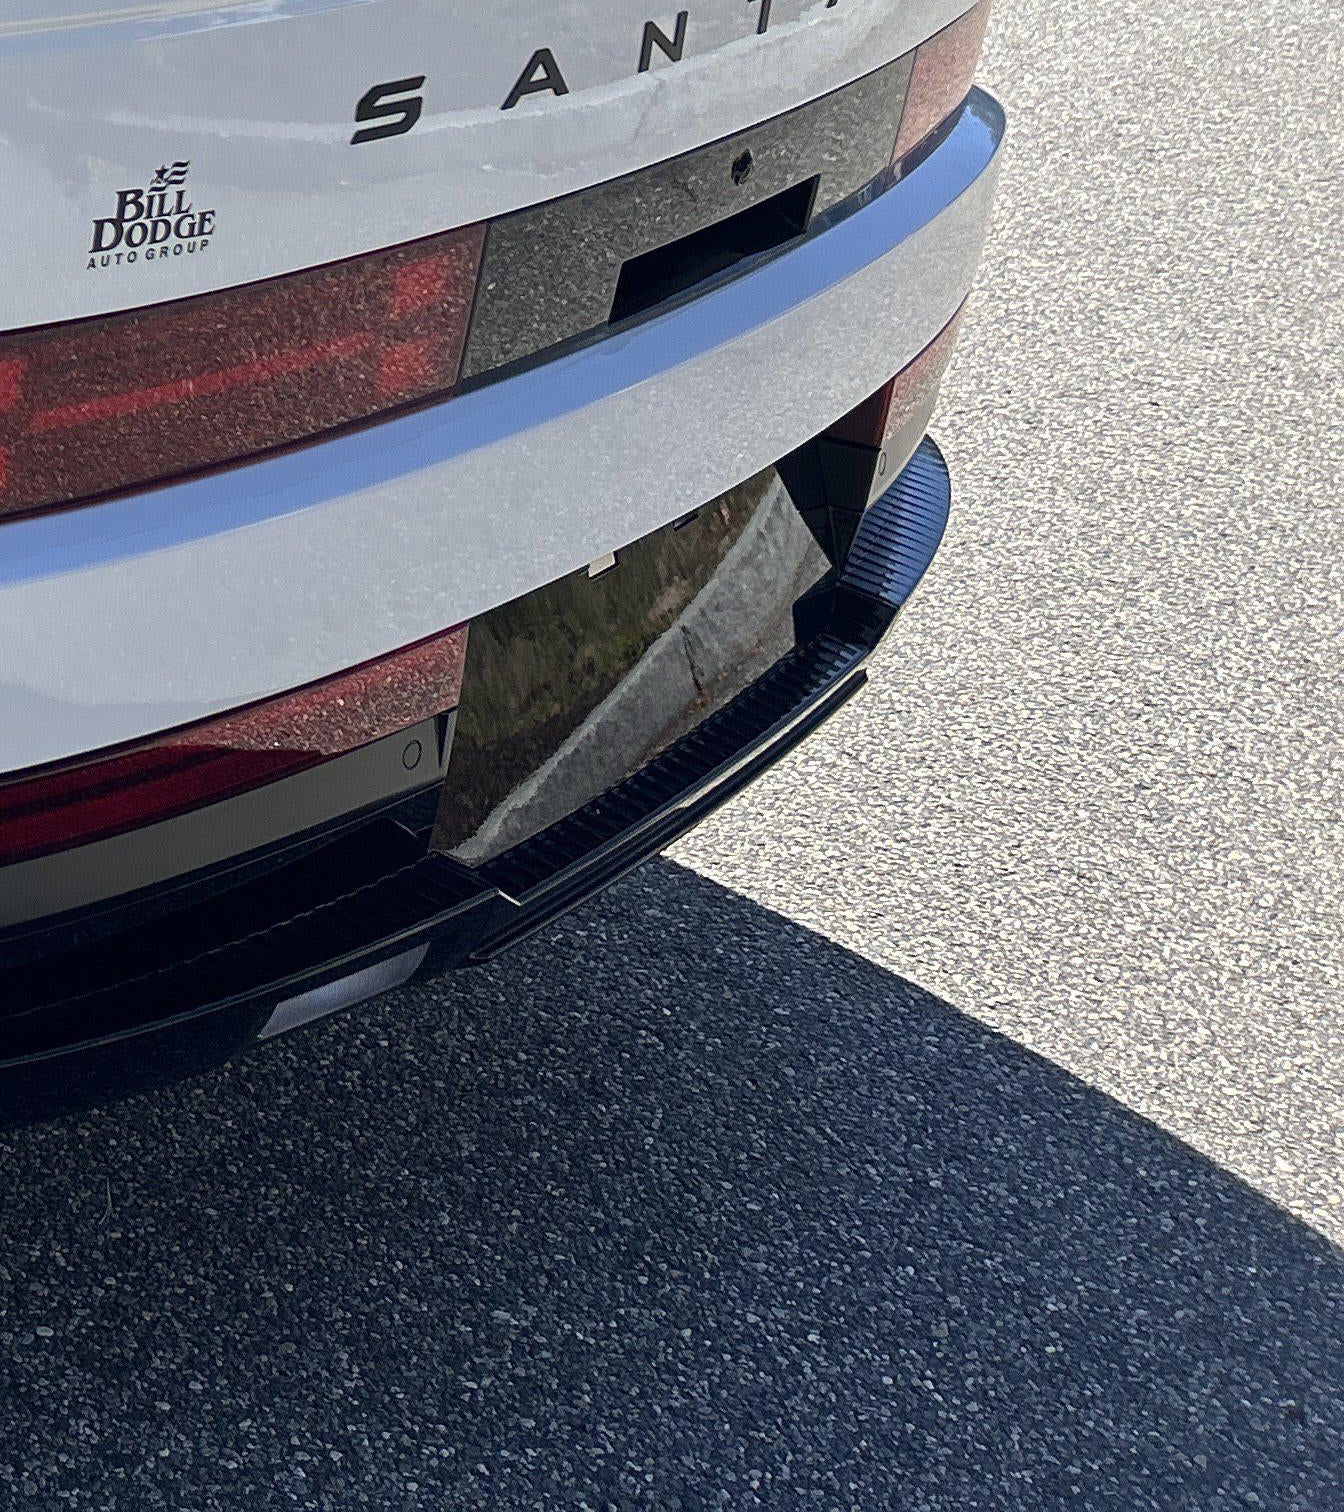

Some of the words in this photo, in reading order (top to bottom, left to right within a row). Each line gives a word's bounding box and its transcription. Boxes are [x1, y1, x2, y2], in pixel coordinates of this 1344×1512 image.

[115, 188, 193, 223] BILL
[88, 209, 217, 253] DODGE
[86, 250, 139, 270] AUTO
[144, 239, 210, 261] GROUP
